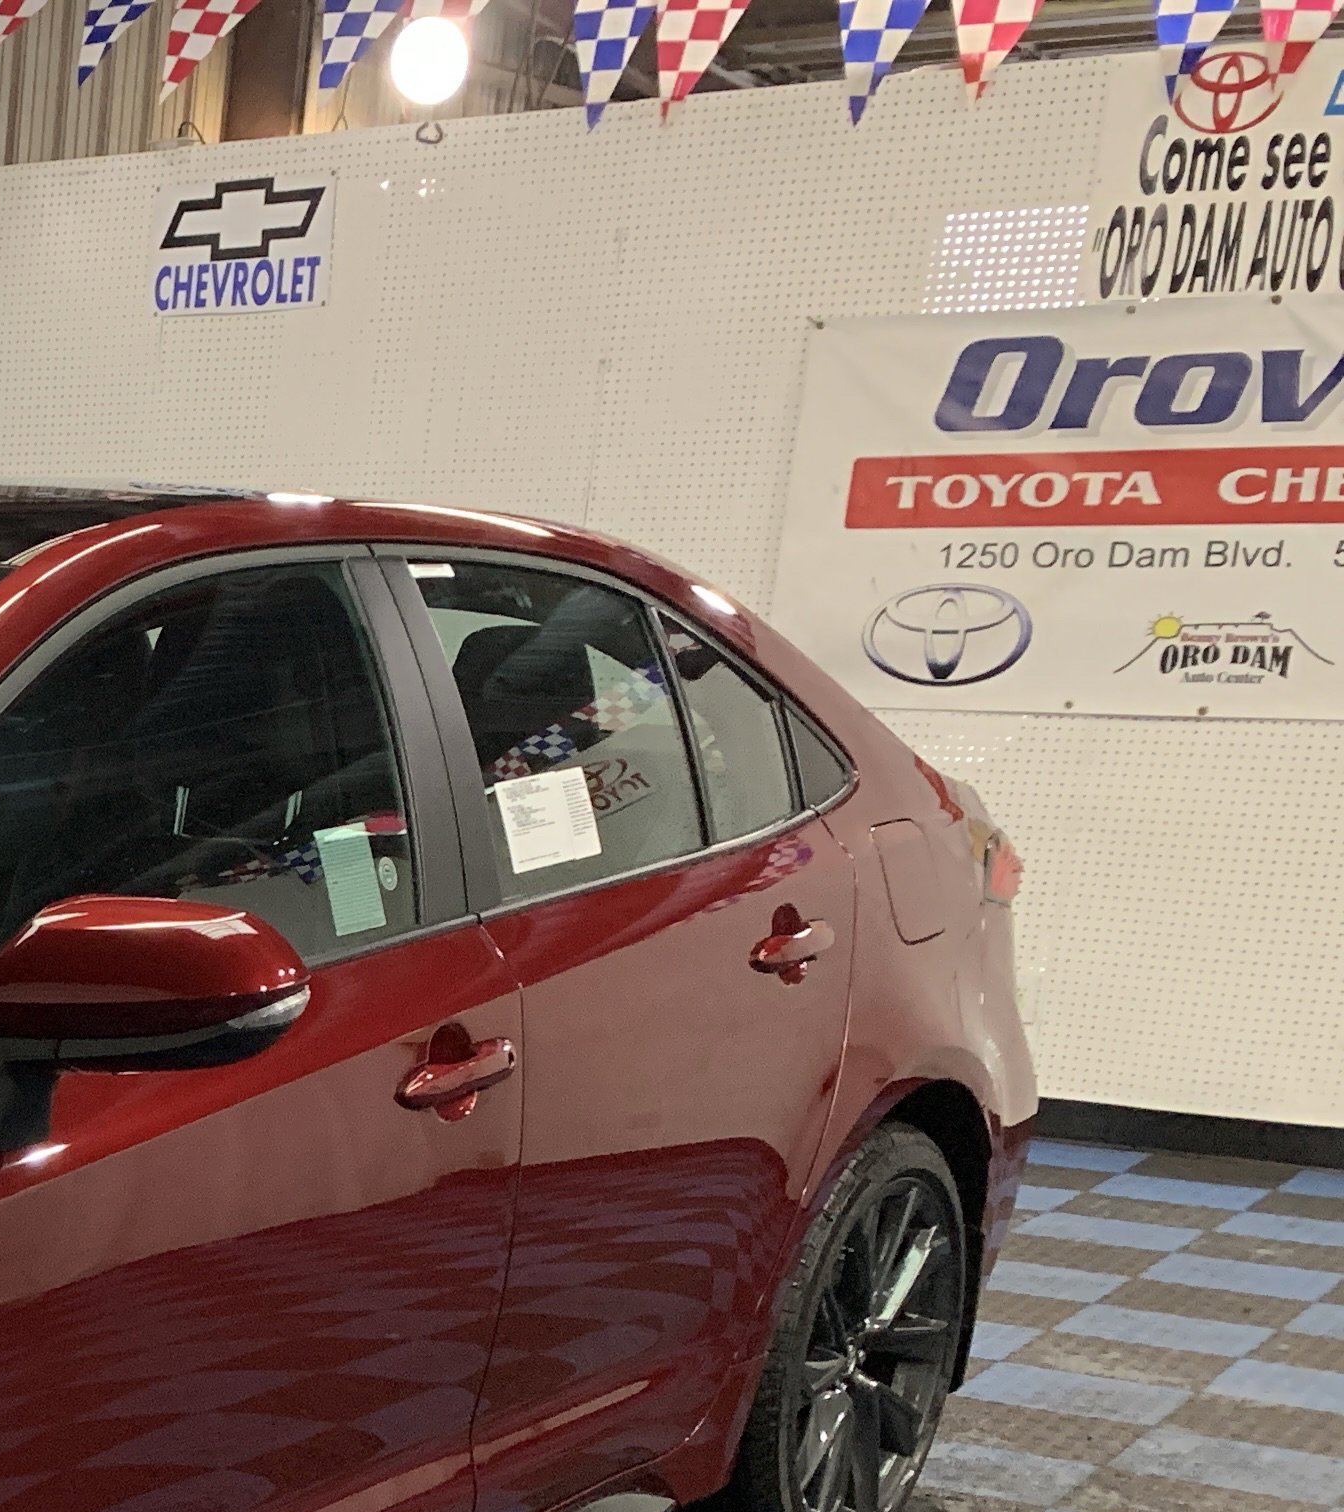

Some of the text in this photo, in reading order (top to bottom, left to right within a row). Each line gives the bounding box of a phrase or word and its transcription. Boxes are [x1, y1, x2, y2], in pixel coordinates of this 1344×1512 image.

[1139, 114, 1331, 195] Come see
[1169, 201, 1247, 294] DAM
[1245, 196, 1335, 292] AUTO
[154, 256, 321, 311] CHEVROLET
[885, 470, 1162, 510] TOYOTA
[939, 539, 1293, 569] 1250 Oro Dam Blvd.
[1159, 644, 1295, 679] ORO DAM
[1179, 671, 1266, 685] Auto Center
